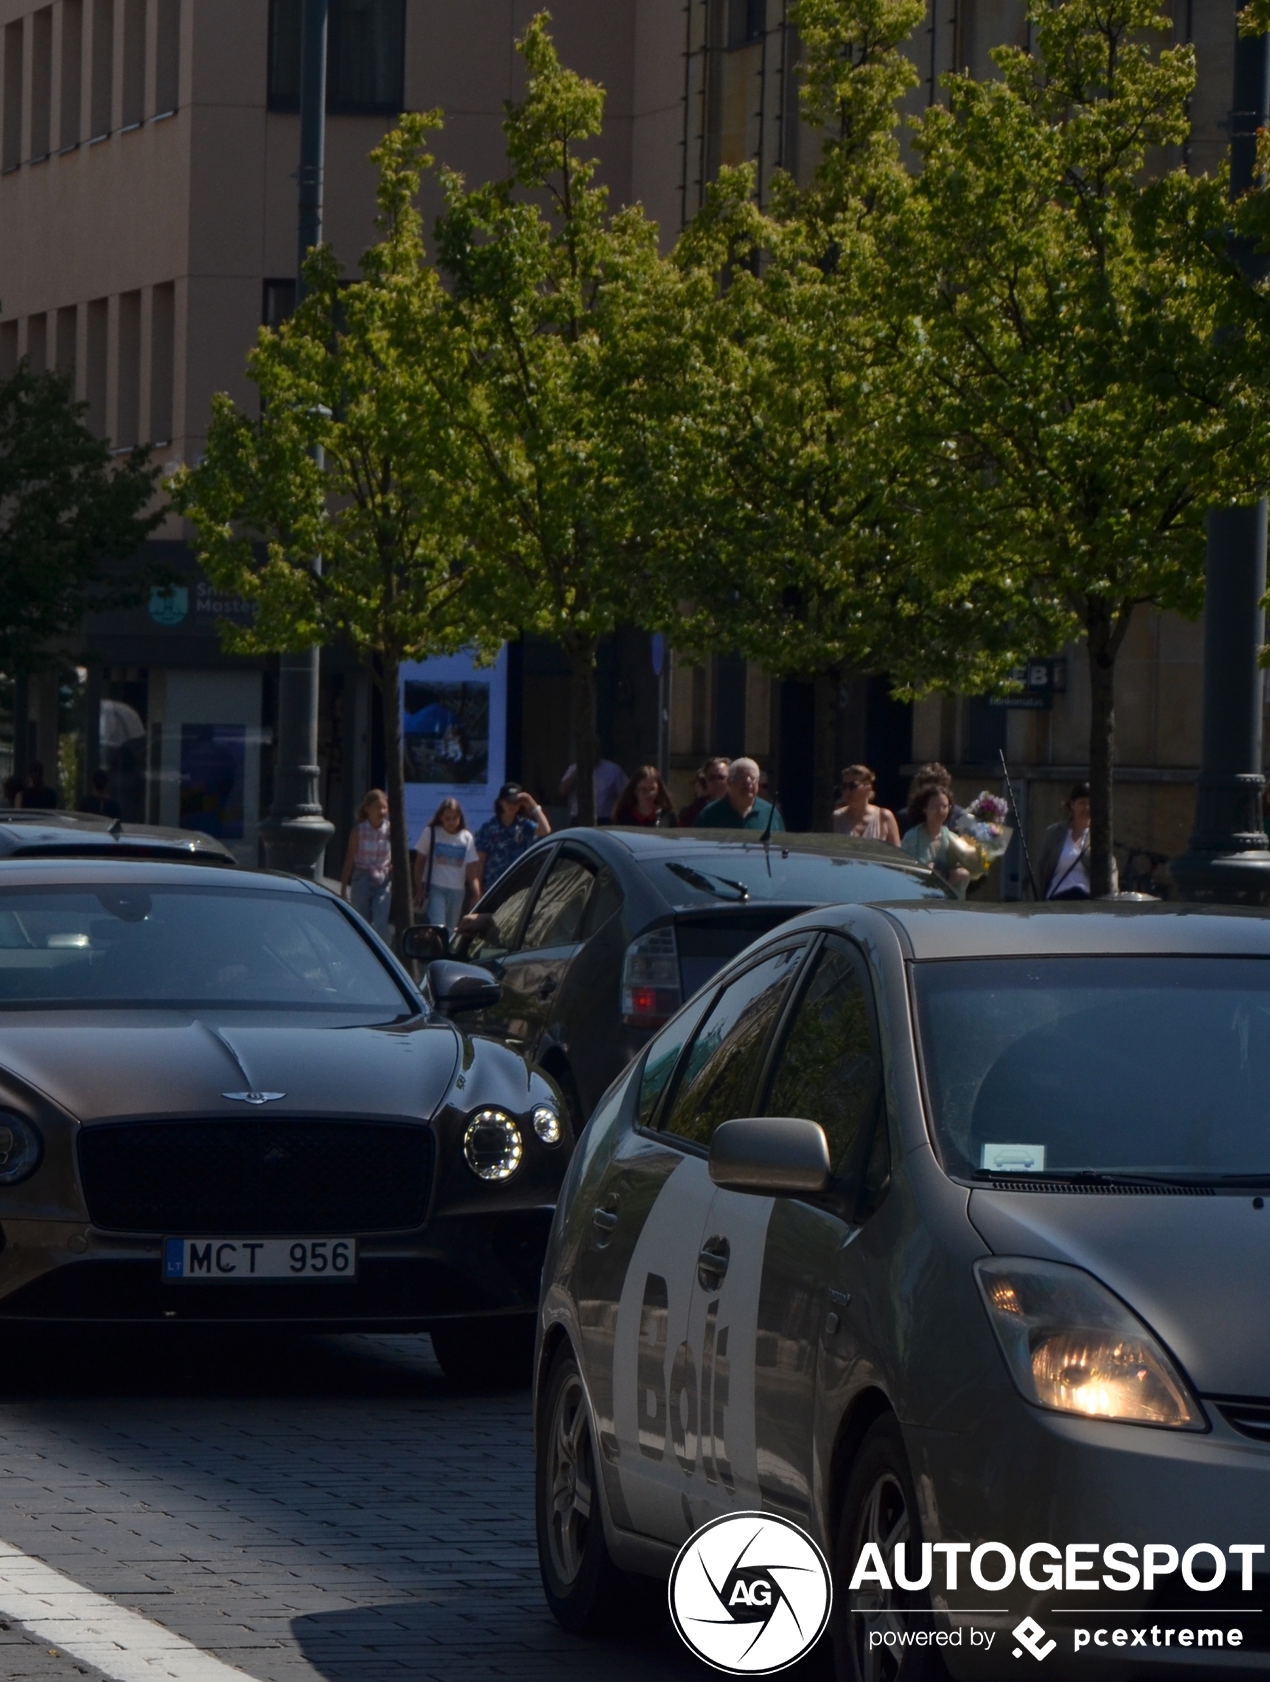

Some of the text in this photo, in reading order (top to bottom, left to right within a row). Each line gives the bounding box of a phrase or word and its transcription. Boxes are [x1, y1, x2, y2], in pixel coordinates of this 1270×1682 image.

[167, 1242, 349, 1273] LT MCT 956
[637, 1271, 736, 1496] Bolt
